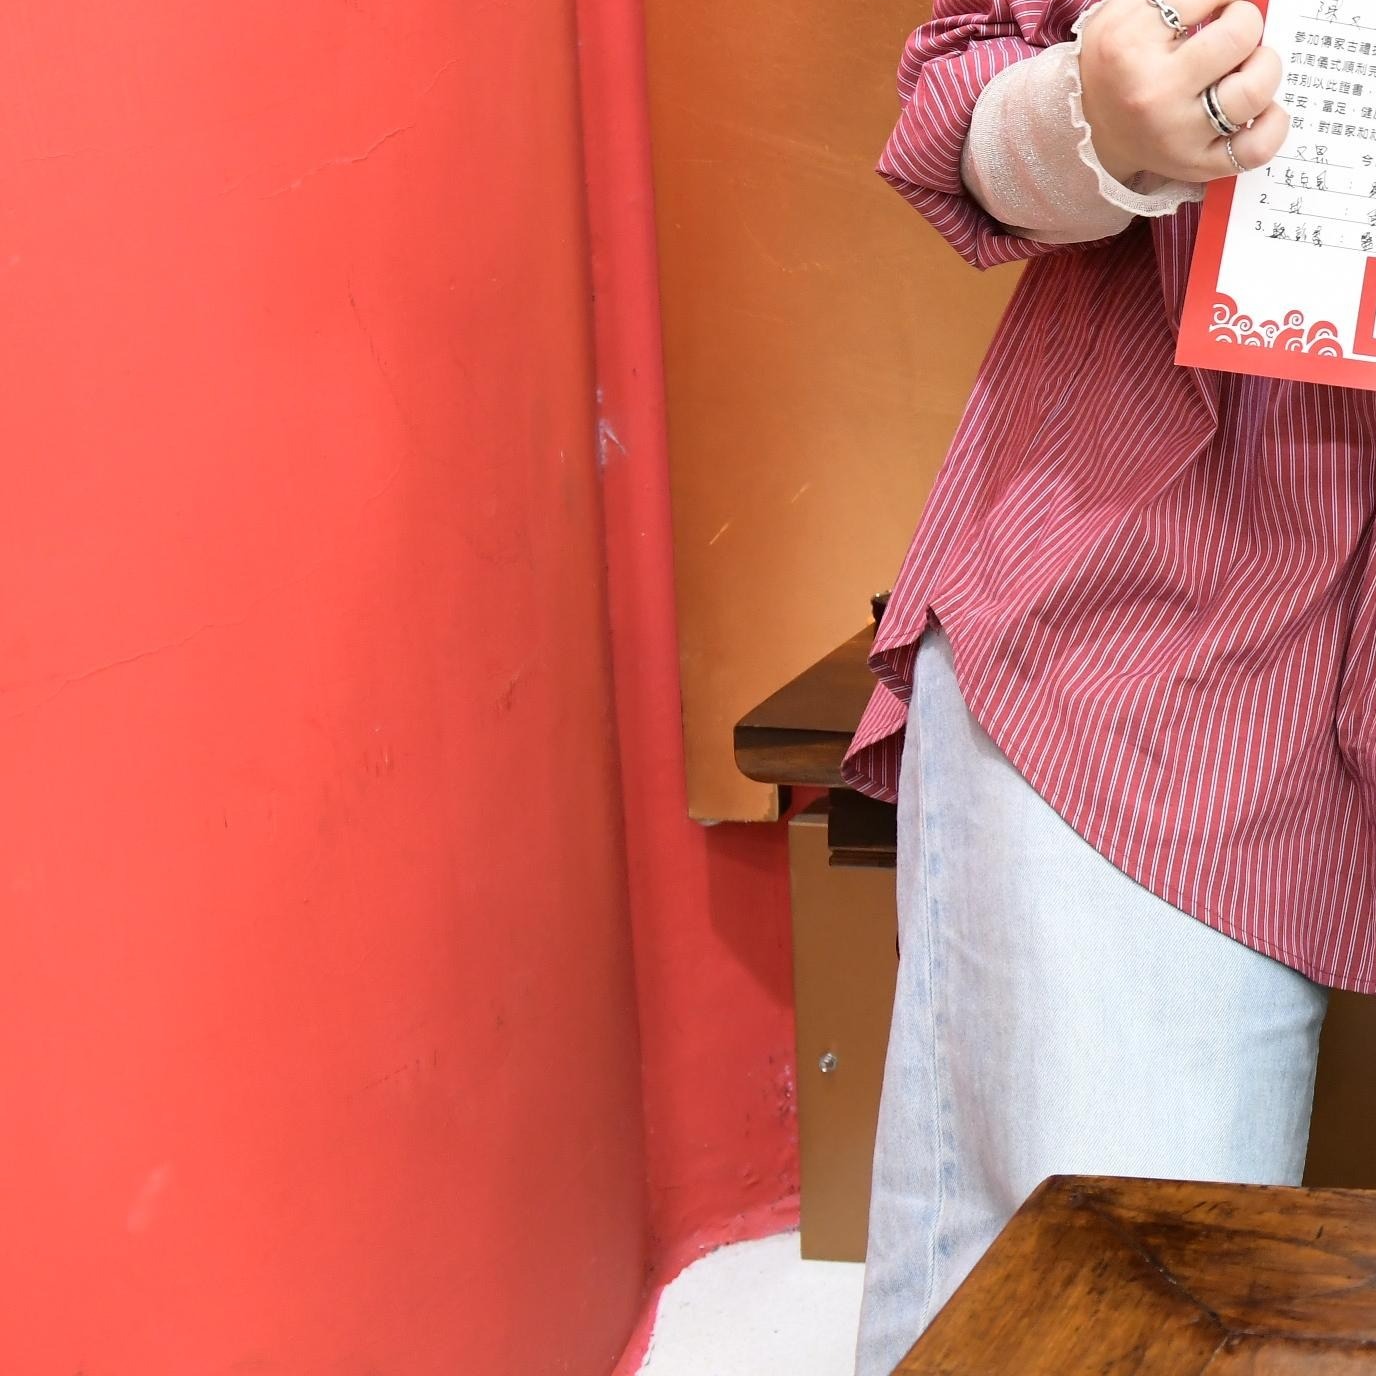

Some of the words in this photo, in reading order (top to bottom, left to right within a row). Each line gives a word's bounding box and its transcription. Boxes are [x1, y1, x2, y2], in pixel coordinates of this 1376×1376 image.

[1265, 166, 1275, 178] 1.
[1259, 193, 1270, 205] 2.
[1254, 220, 1265, 232] 3.
